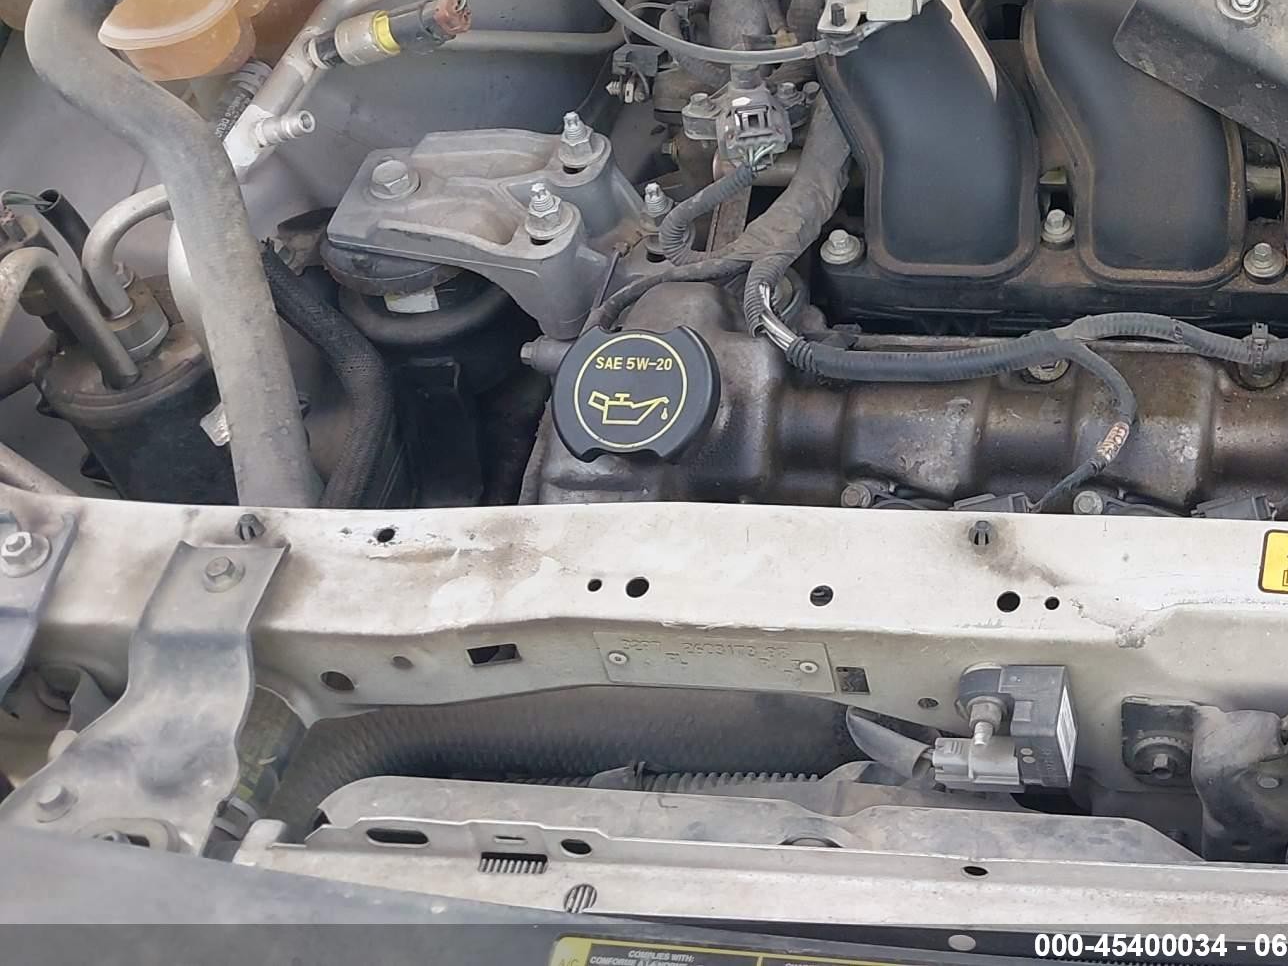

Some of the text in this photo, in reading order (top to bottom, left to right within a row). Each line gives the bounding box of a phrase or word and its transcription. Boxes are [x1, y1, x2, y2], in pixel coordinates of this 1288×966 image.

[595, 356, 673, 371] SAE 5W-20
[628, 950, 695, 963] COMPLIES WITH:
